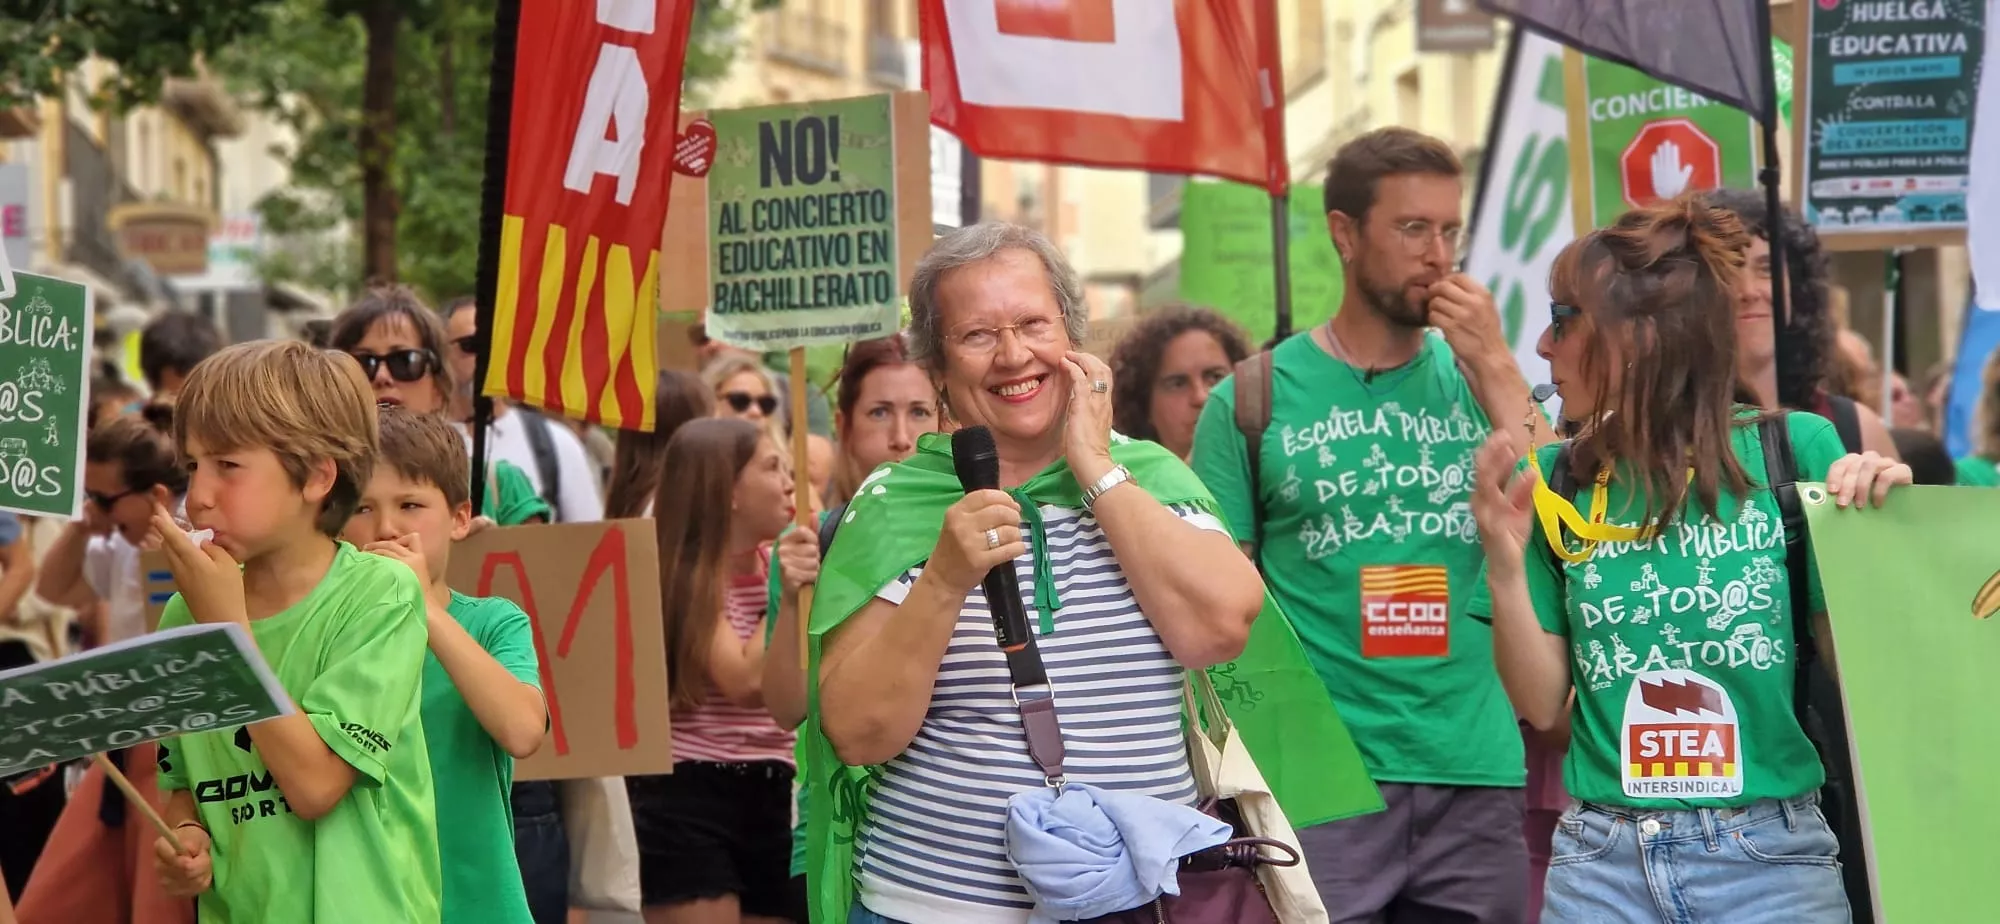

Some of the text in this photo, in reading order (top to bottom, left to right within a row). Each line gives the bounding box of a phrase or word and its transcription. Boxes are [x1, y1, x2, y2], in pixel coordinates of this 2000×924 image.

[1852, 1, 1947, 22] HUELGA
[1829, 32, 1968, 56] EDUCATIVA
[1852, 94, 1936, 110] CONTRA LA
[759, 115, 840, 188] NO!
[718, 189, 887, 235] AL CONCIERTO
[719, 229, 888, 275] EDUCATIVO EN
[713, 270, 890, 314] BACHILLERATO
[1283, 408, 1393, 456] ESCUELA
[1314, 470, 1358, 503] DE
[1306, 512, 1393, 552] PARA
[1678, 513, 1785, 558] PÚBLICA
[1366, 601, 1447, 622] CCOO
[1580, 580, 1773, 629] DE TOD@S
[1368, 622, 1445, 636] enseñanza
[1577, 636, 1786, 682] PARA TOD@S
[14, 687, 205, 735] TOD@S
[67, 704, 257, 750] TOD@S
[1639, 729, 1725, 758] STEA
[1627, 781, 1739, 794] INTERSINDICAL
